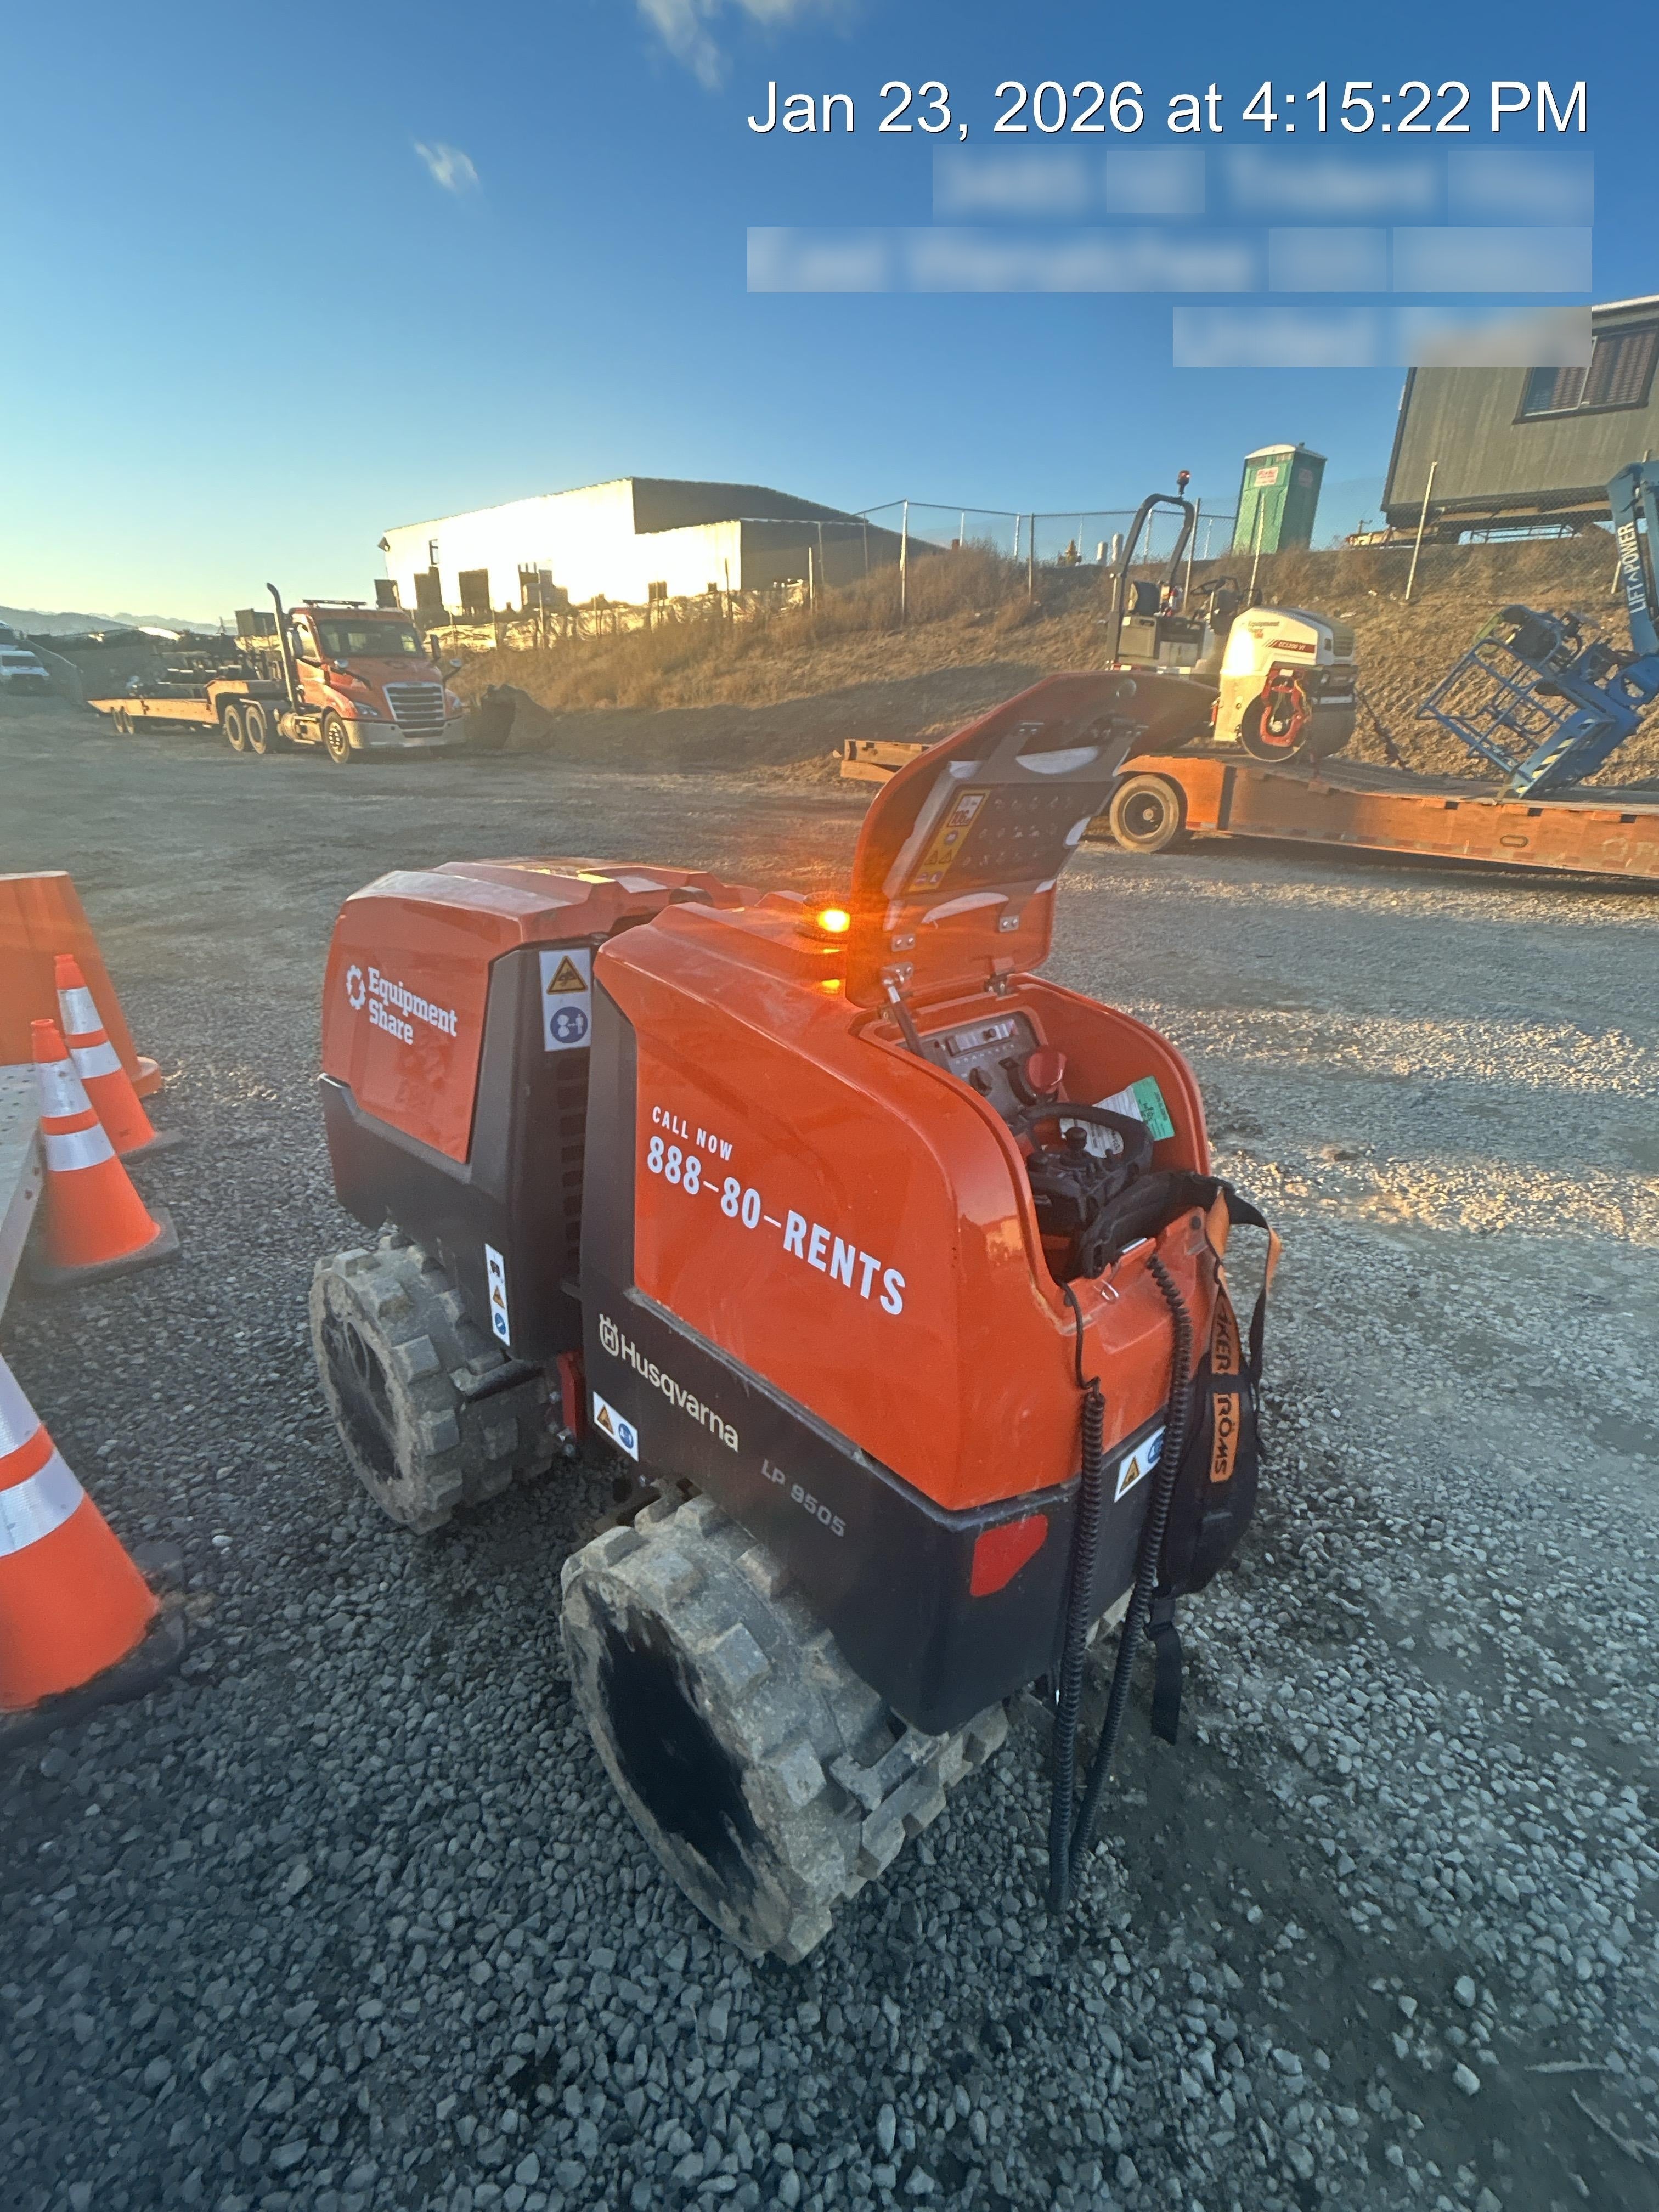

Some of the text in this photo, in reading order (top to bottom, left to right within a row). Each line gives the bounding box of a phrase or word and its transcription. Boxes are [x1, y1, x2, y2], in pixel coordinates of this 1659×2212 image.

[368, 966, 458, 1037] Equipment
[368, 998, 414, 1045] Share
[652, 1105, 733, 1161] CALL NOW
[647, 1136, 906, 1316] 888-80-RENTS
[620, 1334, 739, 1453] Husqvarna
[761, 1458, 847, 1537] LP 9505
